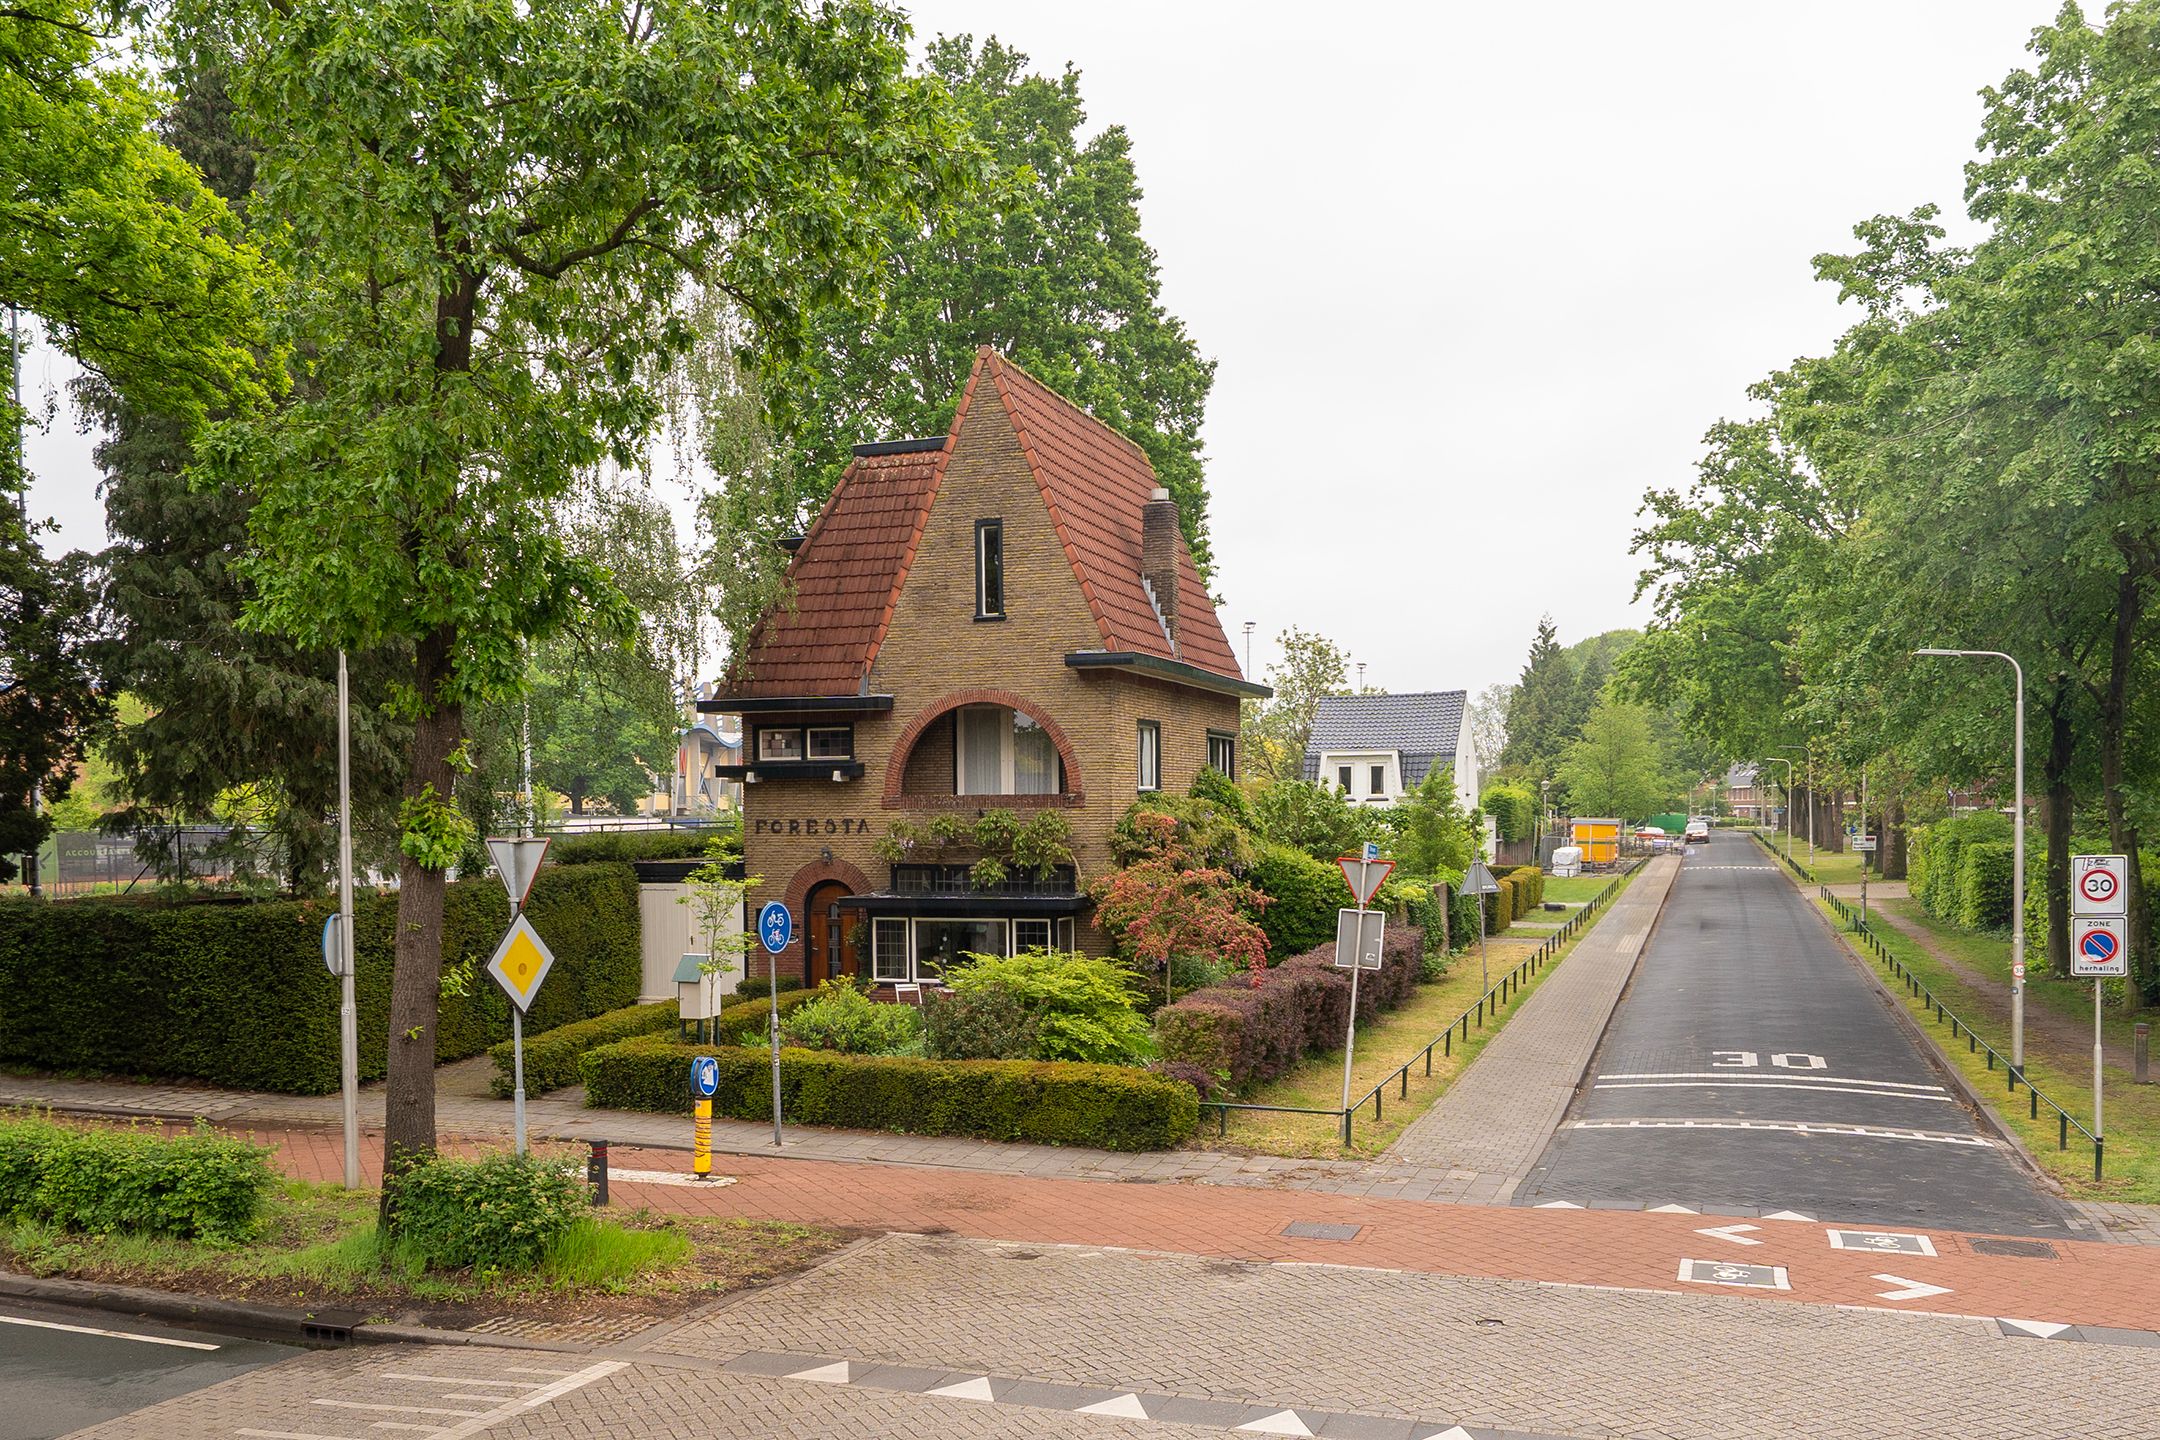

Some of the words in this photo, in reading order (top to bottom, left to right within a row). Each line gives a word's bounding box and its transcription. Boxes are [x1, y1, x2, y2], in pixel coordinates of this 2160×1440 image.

[755, 818, 870, 835] FORESTA
[2088, 879, 2112, 892] 30
[1712, 1051, 1828, 1070] 30
